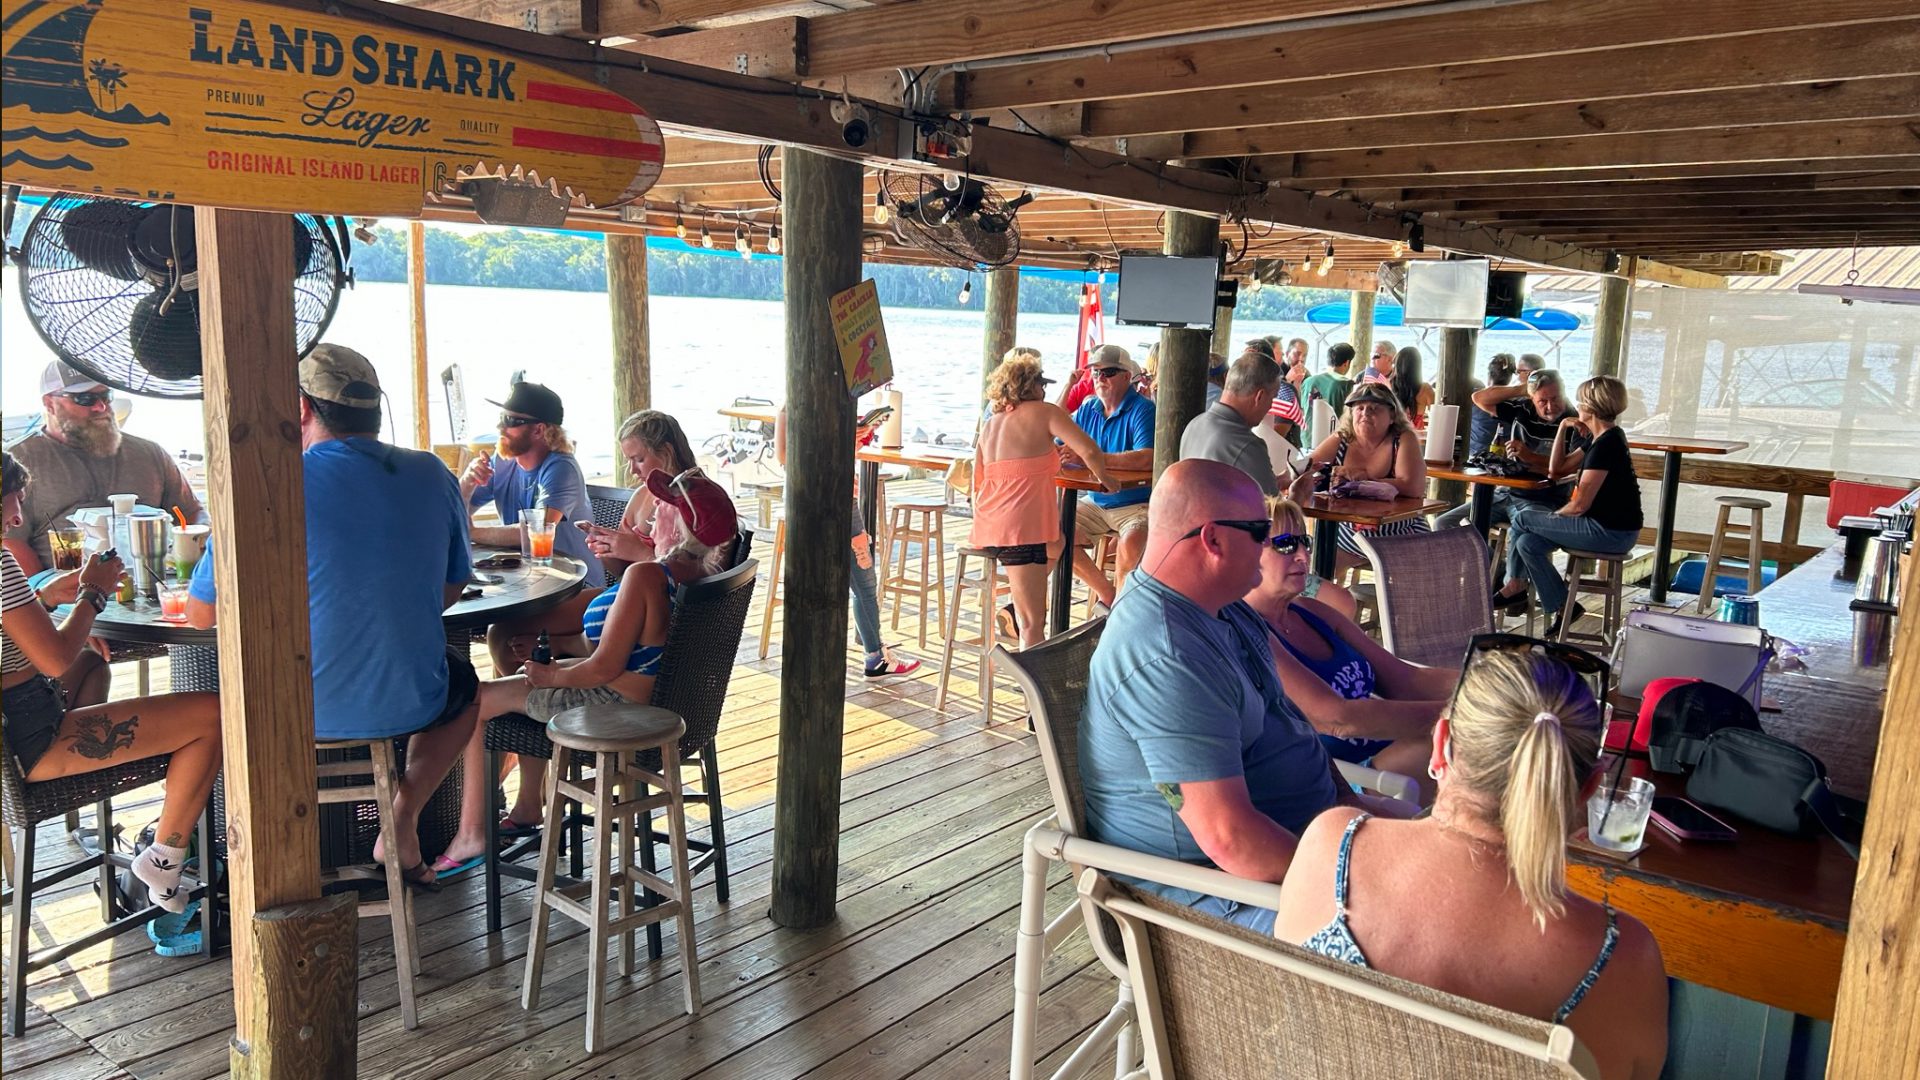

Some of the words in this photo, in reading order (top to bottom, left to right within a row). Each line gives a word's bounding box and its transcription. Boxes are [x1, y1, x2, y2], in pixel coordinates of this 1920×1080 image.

[207, 88, 265, 107] PREMIUM
[301, 87, 430, 148] Lager
[460, 119, 500, 134] QUALITY
[207, 150, 296, 176] ORIGINAL
[303, 158, 364, 181] ISLAND
[370, 165, 420, 185] LAGER
